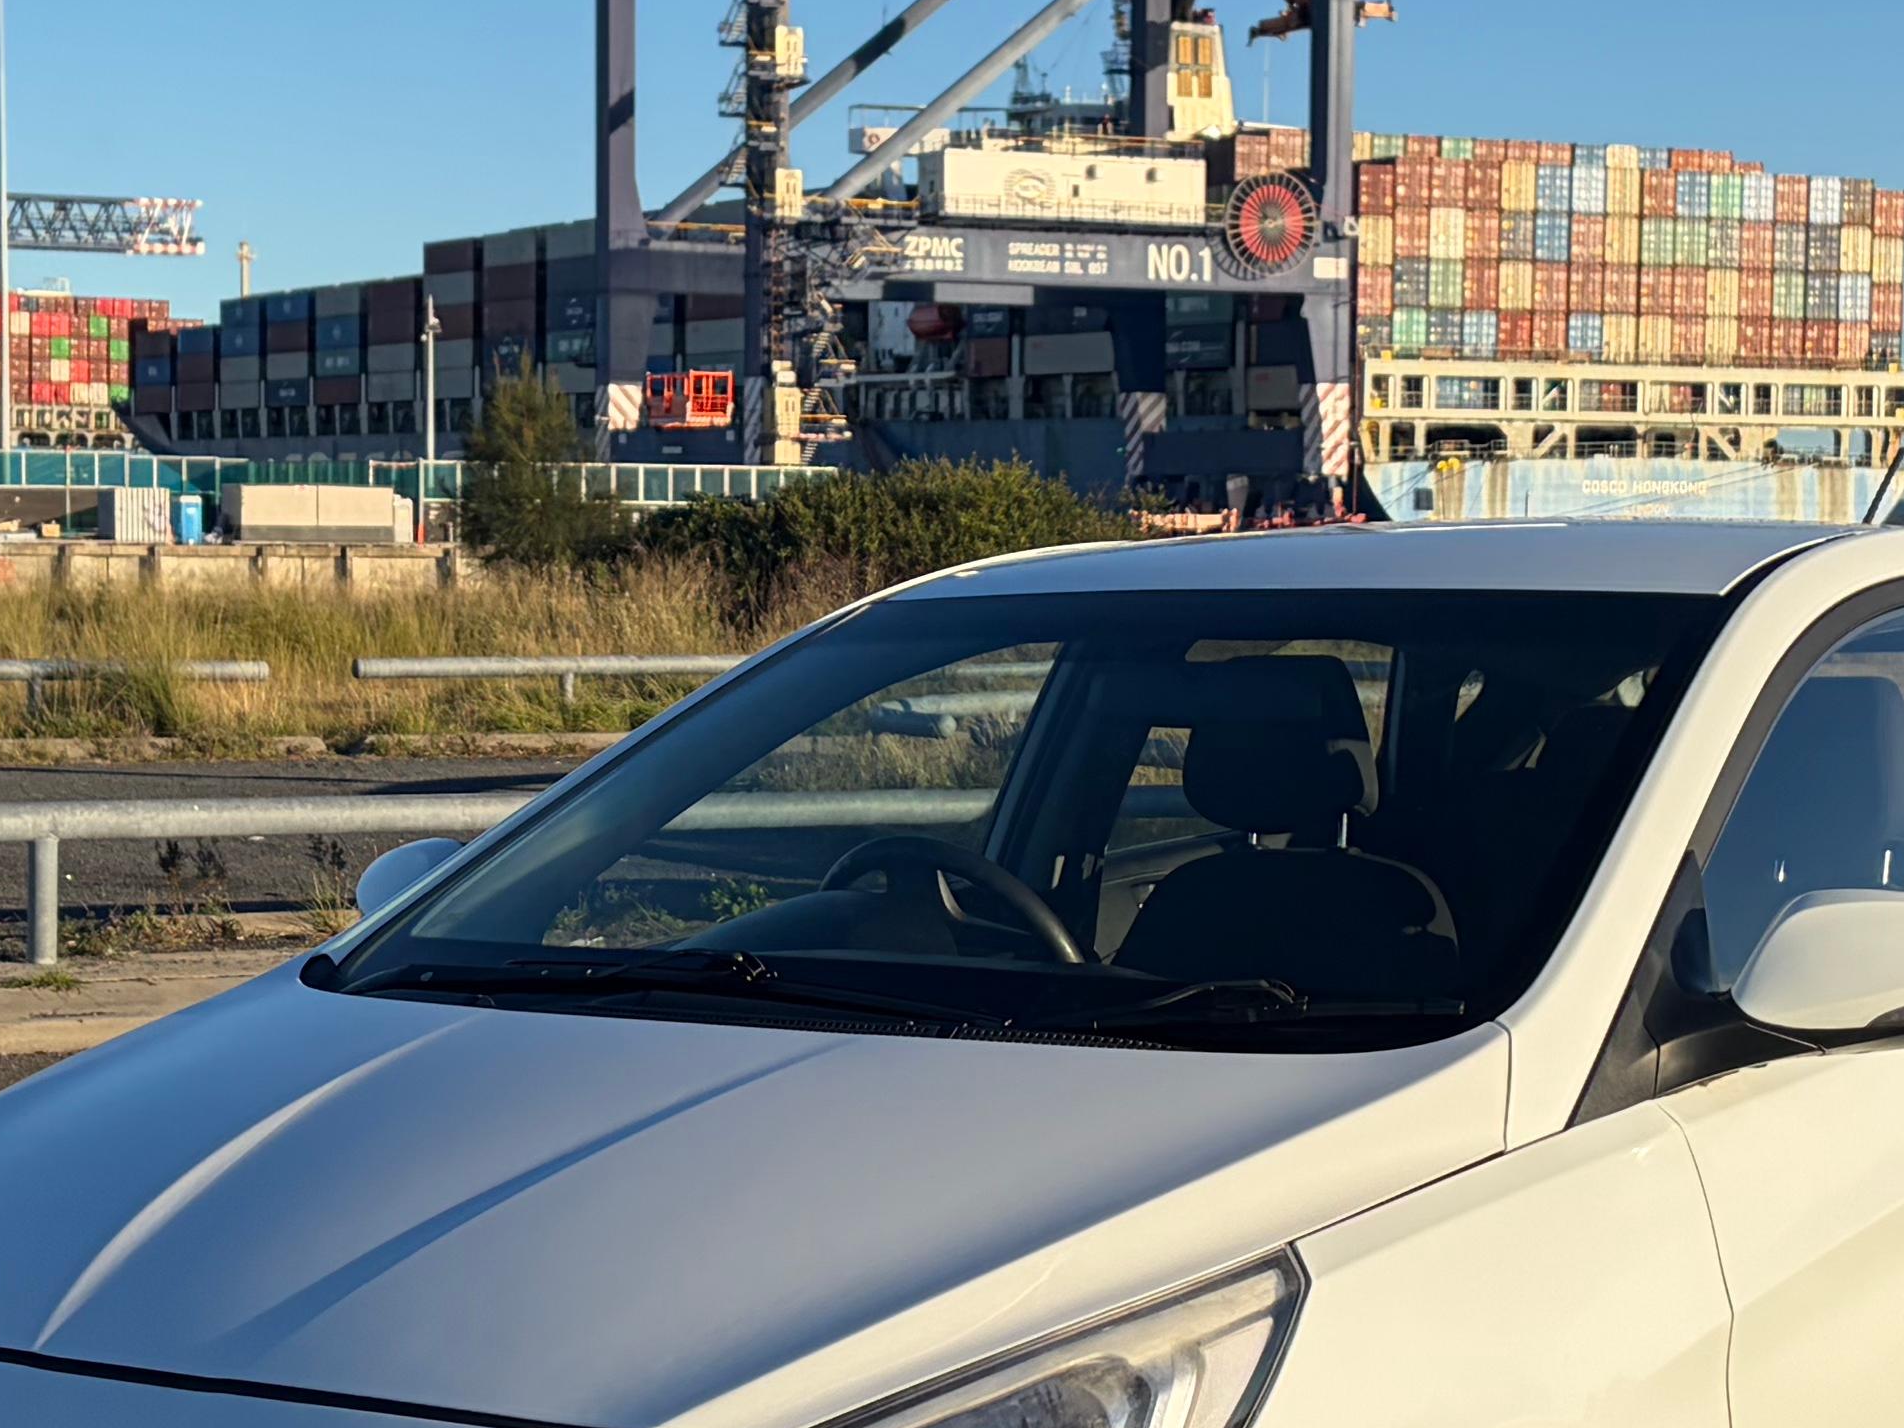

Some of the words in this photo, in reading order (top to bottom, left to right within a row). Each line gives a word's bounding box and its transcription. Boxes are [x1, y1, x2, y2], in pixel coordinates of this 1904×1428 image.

[904, 235, 964, 258] ZPMC
[1148, 243, 1212, 283] NO.1
[1582, 479, 1627, 495] COSCO
[1632, 479, 1708, 496] HONGKONG
